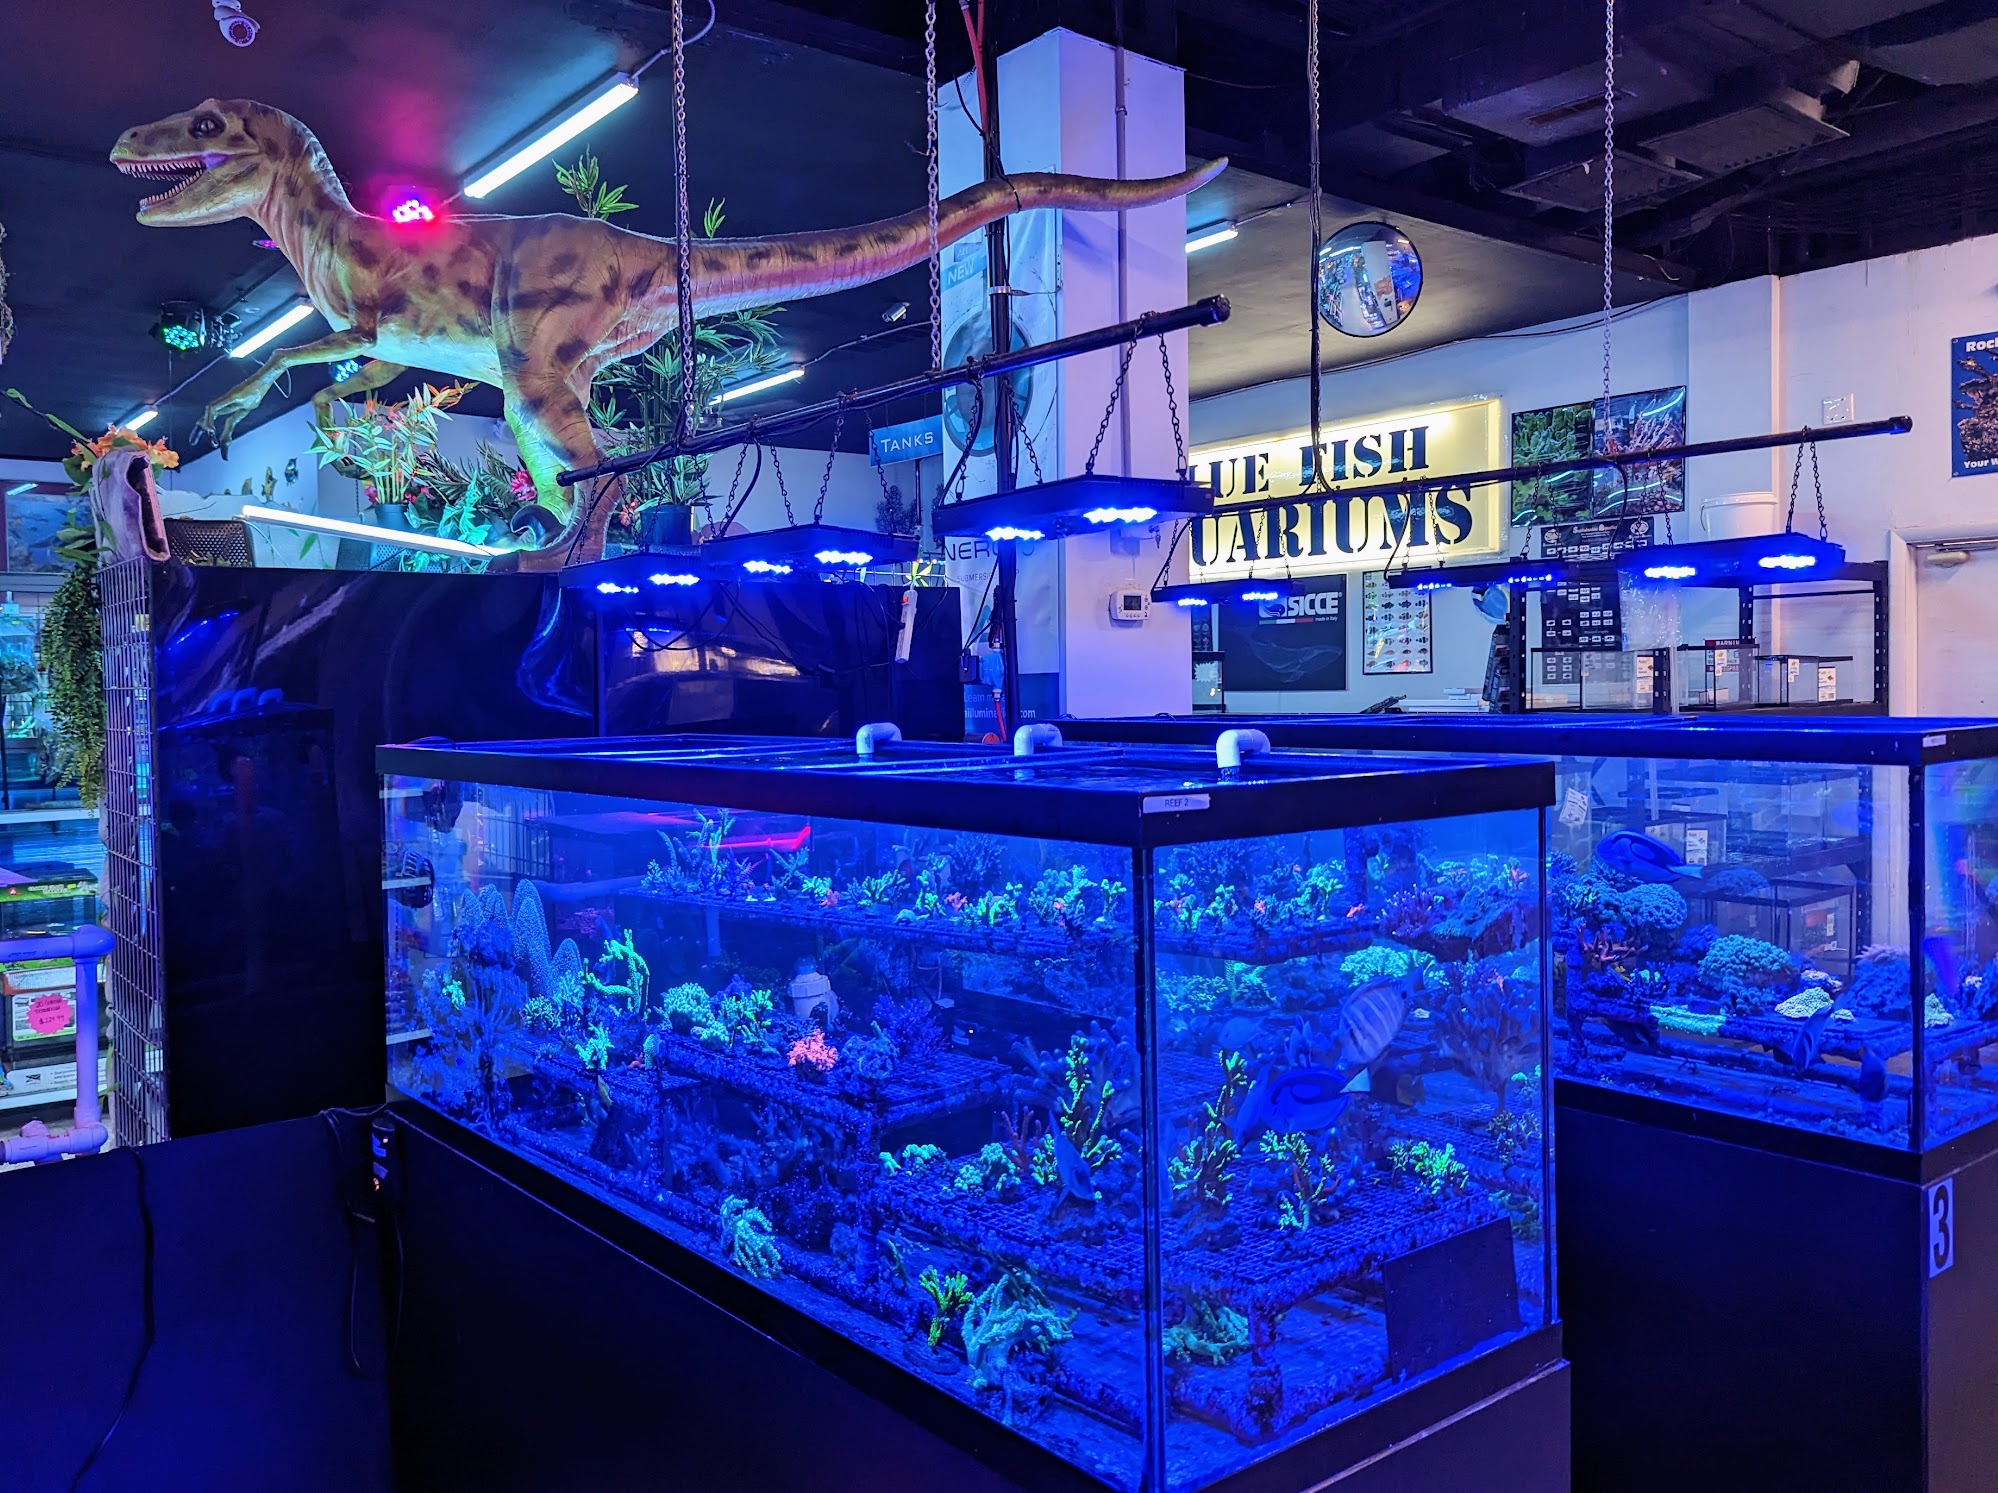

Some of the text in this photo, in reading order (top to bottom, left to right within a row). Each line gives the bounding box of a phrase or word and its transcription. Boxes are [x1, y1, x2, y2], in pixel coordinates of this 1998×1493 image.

[947, 256, 975, 285] NEW
[880, 431, 934, 453] TANKS
[1190, 426, 1429, 498] UE FISH
[1287, 592, 1338, 616] SICCE
[1164, 798, 1189, 808] REEF 2
[1932, 1184, 1950, 1270] 3
